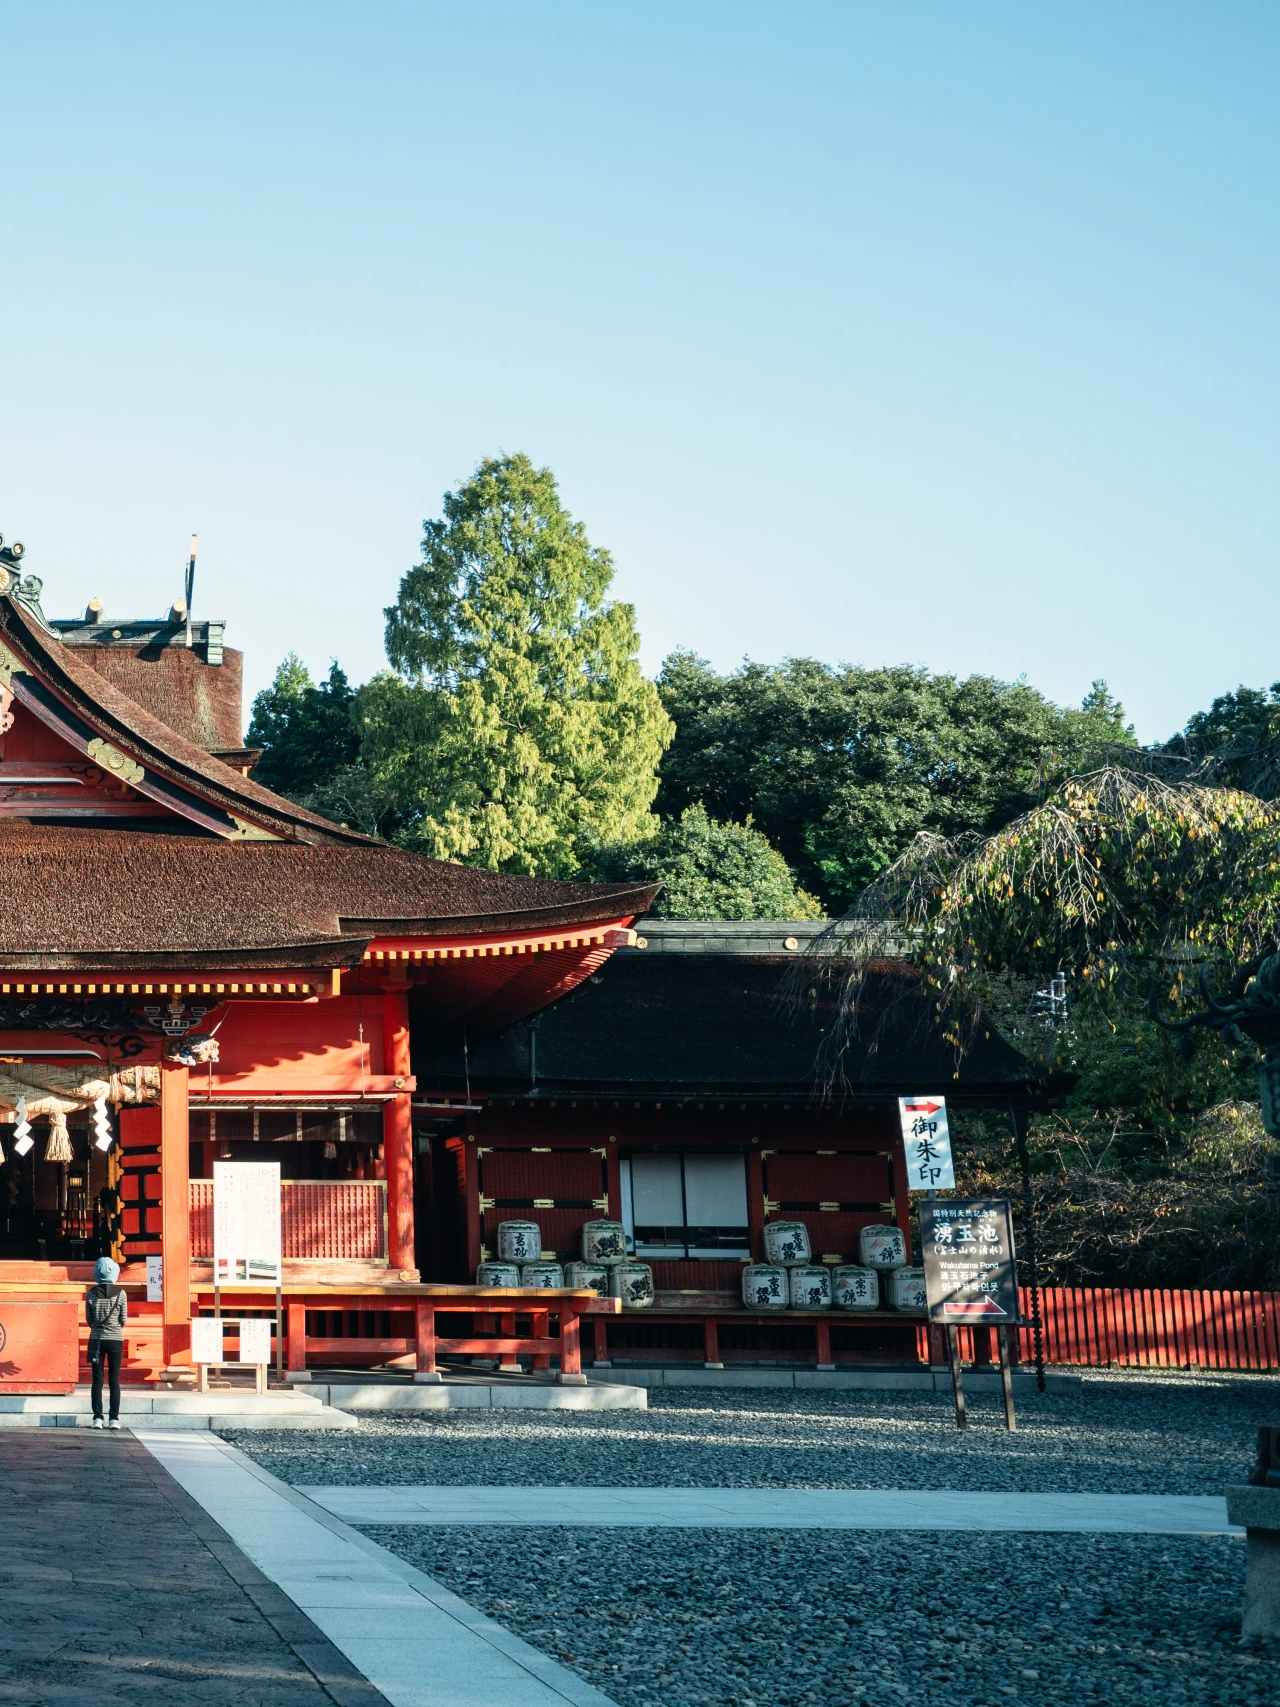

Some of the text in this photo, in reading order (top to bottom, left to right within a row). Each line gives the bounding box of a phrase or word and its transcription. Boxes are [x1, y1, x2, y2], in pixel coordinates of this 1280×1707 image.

[911, 1116, 942, 1185] 御朱印
[933, 1209, 998, 1218] 国特別天然記念物
[933, 1222, 999, 1243] 湧玉池
[855, 1278, 867, 1297] 富士
